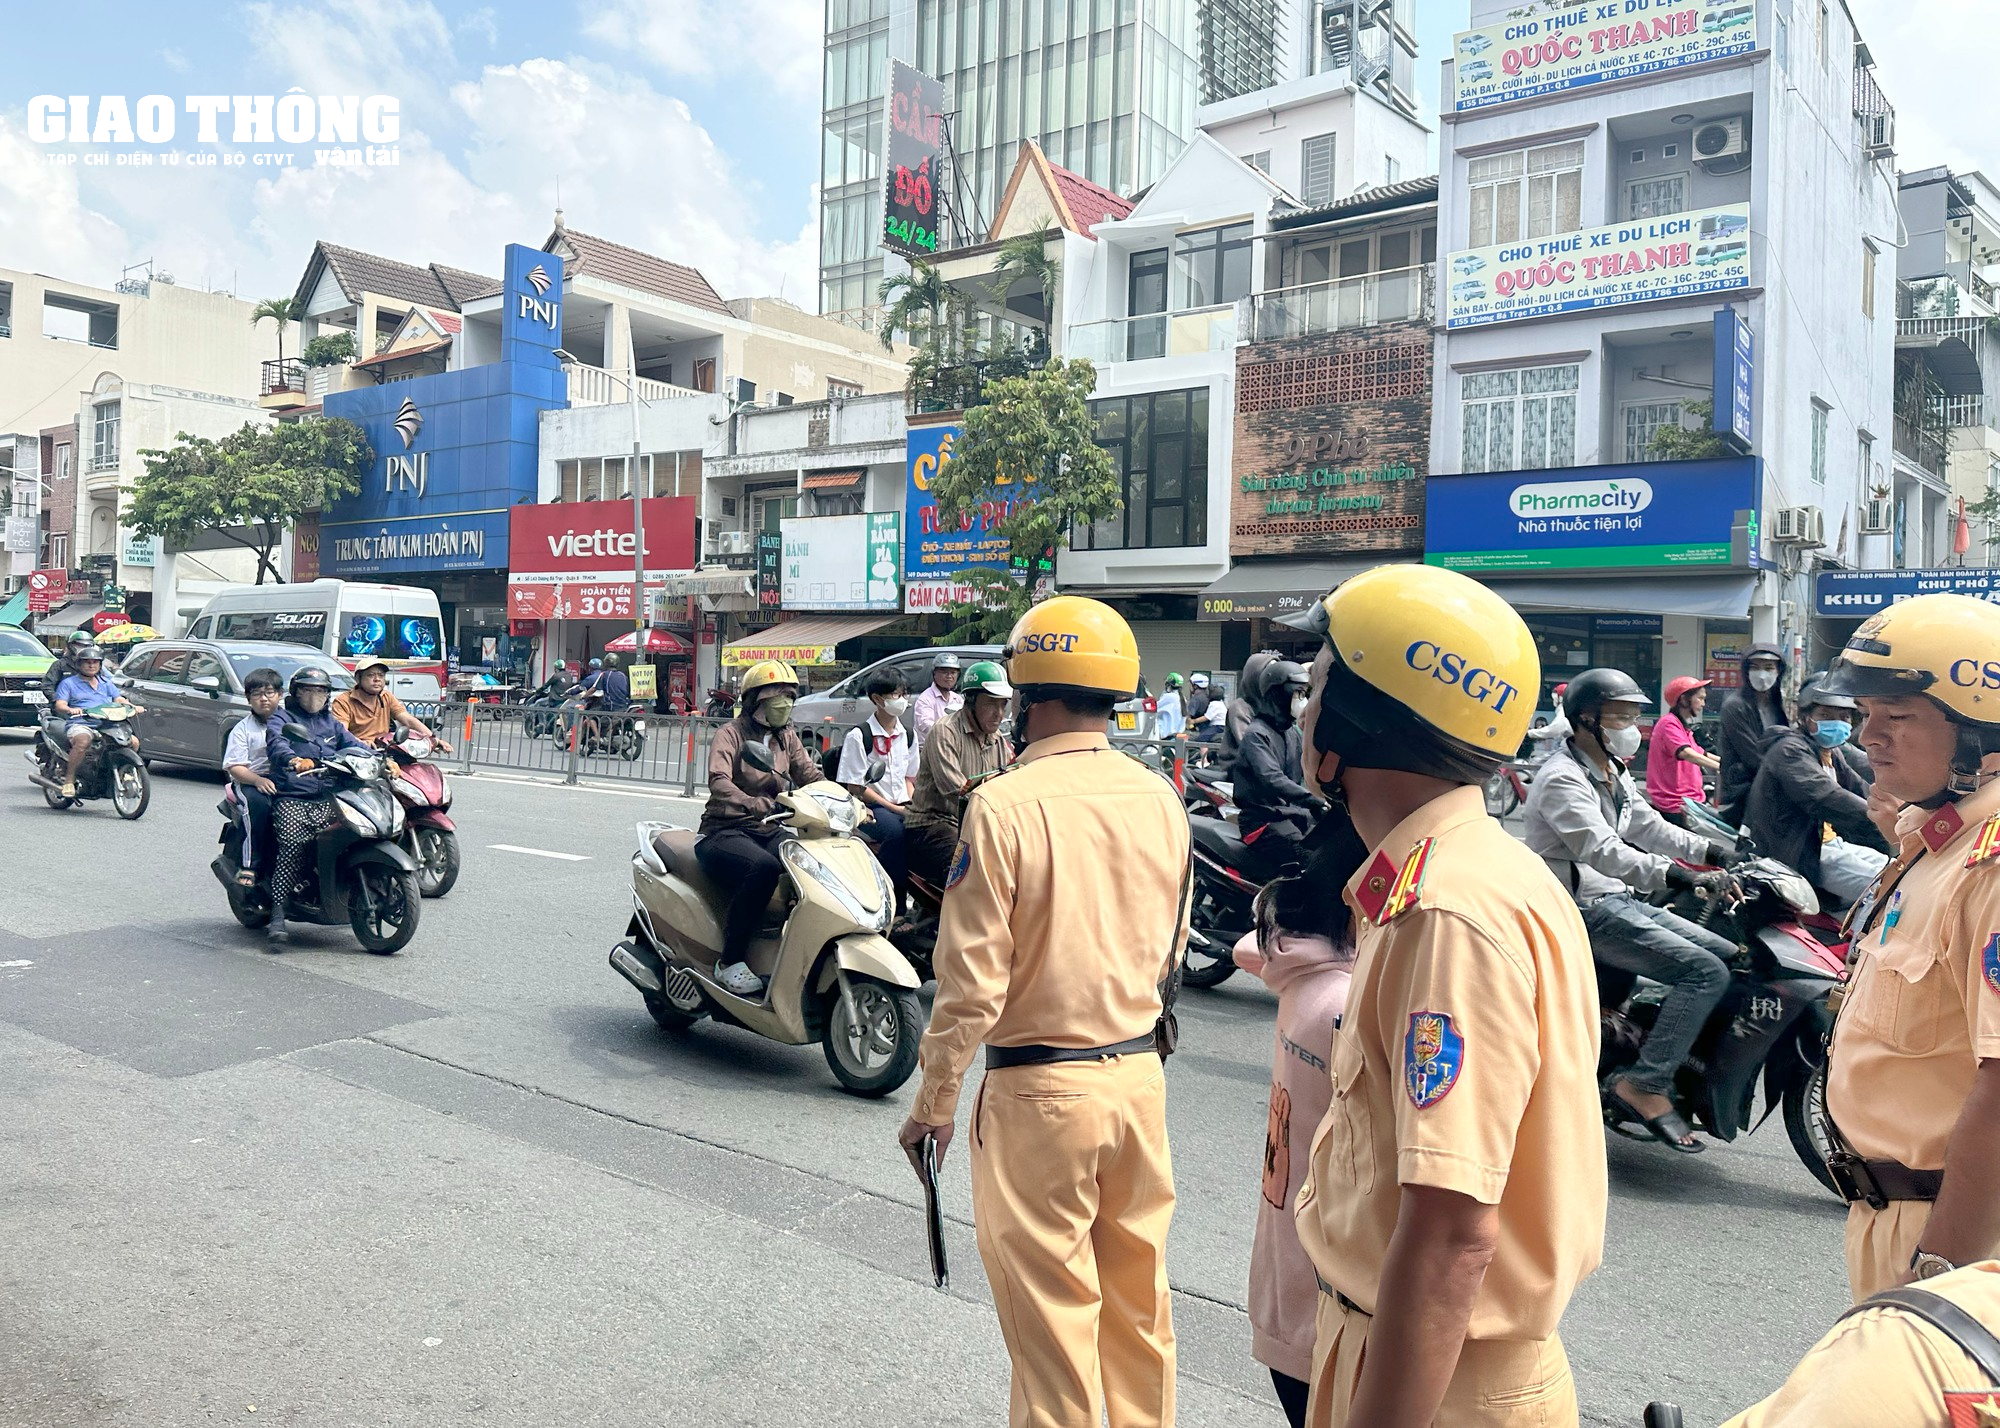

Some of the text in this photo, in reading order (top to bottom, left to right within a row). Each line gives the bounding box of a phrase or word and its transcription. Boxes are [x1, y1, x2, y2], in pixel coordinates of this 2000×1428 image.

[1505, 0, 1649, 41] CHO THUÊ XE DU
[1501, 9, 1699, 76] QUỐC THANH
[1618, 65, 1640, 76] 0913
[1642, 61, 1660, 72] 713
[1710, 47, 1728, 58] 374
[1730, 43, 1749, 54] 972
[1460, 85, 1477, 99] SÂN
[1561, 65, 1582, 78] LỊCH
[1584, 60, 1597, 74] CẢ
[1600, 55, 1625, 69] NƯỚC
[1628, 53, 1640, 64] XE
[1461, 100, 1477, 109] 155
[886, 215, 936, 252] 24/24
[1499, 219, 1691, 263] CHO THUÊ XE DU LỊCH
[1495, 241, 1692, 297] QUỐC THANH
[1554, 290, 1575, 301] LỊCH
[1621, 281, 1633, 292] XE
[1610, 293, 1633, 303] 0913
[1635, 290, 1653, 300] 713
[1703, 280, 1721, 289] 374
[1723, 278, 1742, 288] 972
[519, 293, 558, 331] PNJ
[1453, 317, 1469, 326] 155
[385, 451, 432, 499] PNJ
[1269, 472, 1308, 491] riêng
[1372, 462, 1415, 482] nhiên
[1265, 491, 1384, 515] durian farmstay
[1519, 487, 1642, 511] Pharmacity
[919, 498, 975, 534] TÙG
[1518, 515, 1642, 533] Nhà thuốc tiện lợi
[300, 532, 320, 557] NGỌ
[335, 523, 484, 561] TRUNG TÂM KIM HOÀN PNJ
[547, 528, 650, 557] viettel
[761, 535, 780, 549] BÁNH
[785, 540, 809, 557] BÁNH
[978, 540, 1011, 550] LAPTOP
[765, 552, 777, 567] MÌ
[789, 561, 800, 578] MÌ
[580, 584, 631, 596] HOÀN TIỀN
[763, 573, 778, 586] HÀ
[1918, 576, 1989, 589] KHU PHỐ
[760, 590, 781, 607] NỘI
[1204, 599, 1233, 613] 9.000
[1824, 594, 1882, 606] KHU
[272, 613, 324, 624] SOLATI
[1596, 618, 1631, 626] Pharmacity
[1015, 632, 1079, 655] CSGT
[1404, 640, 1519, 715] CSGT
[1949, 658, 2000, 690] CS
